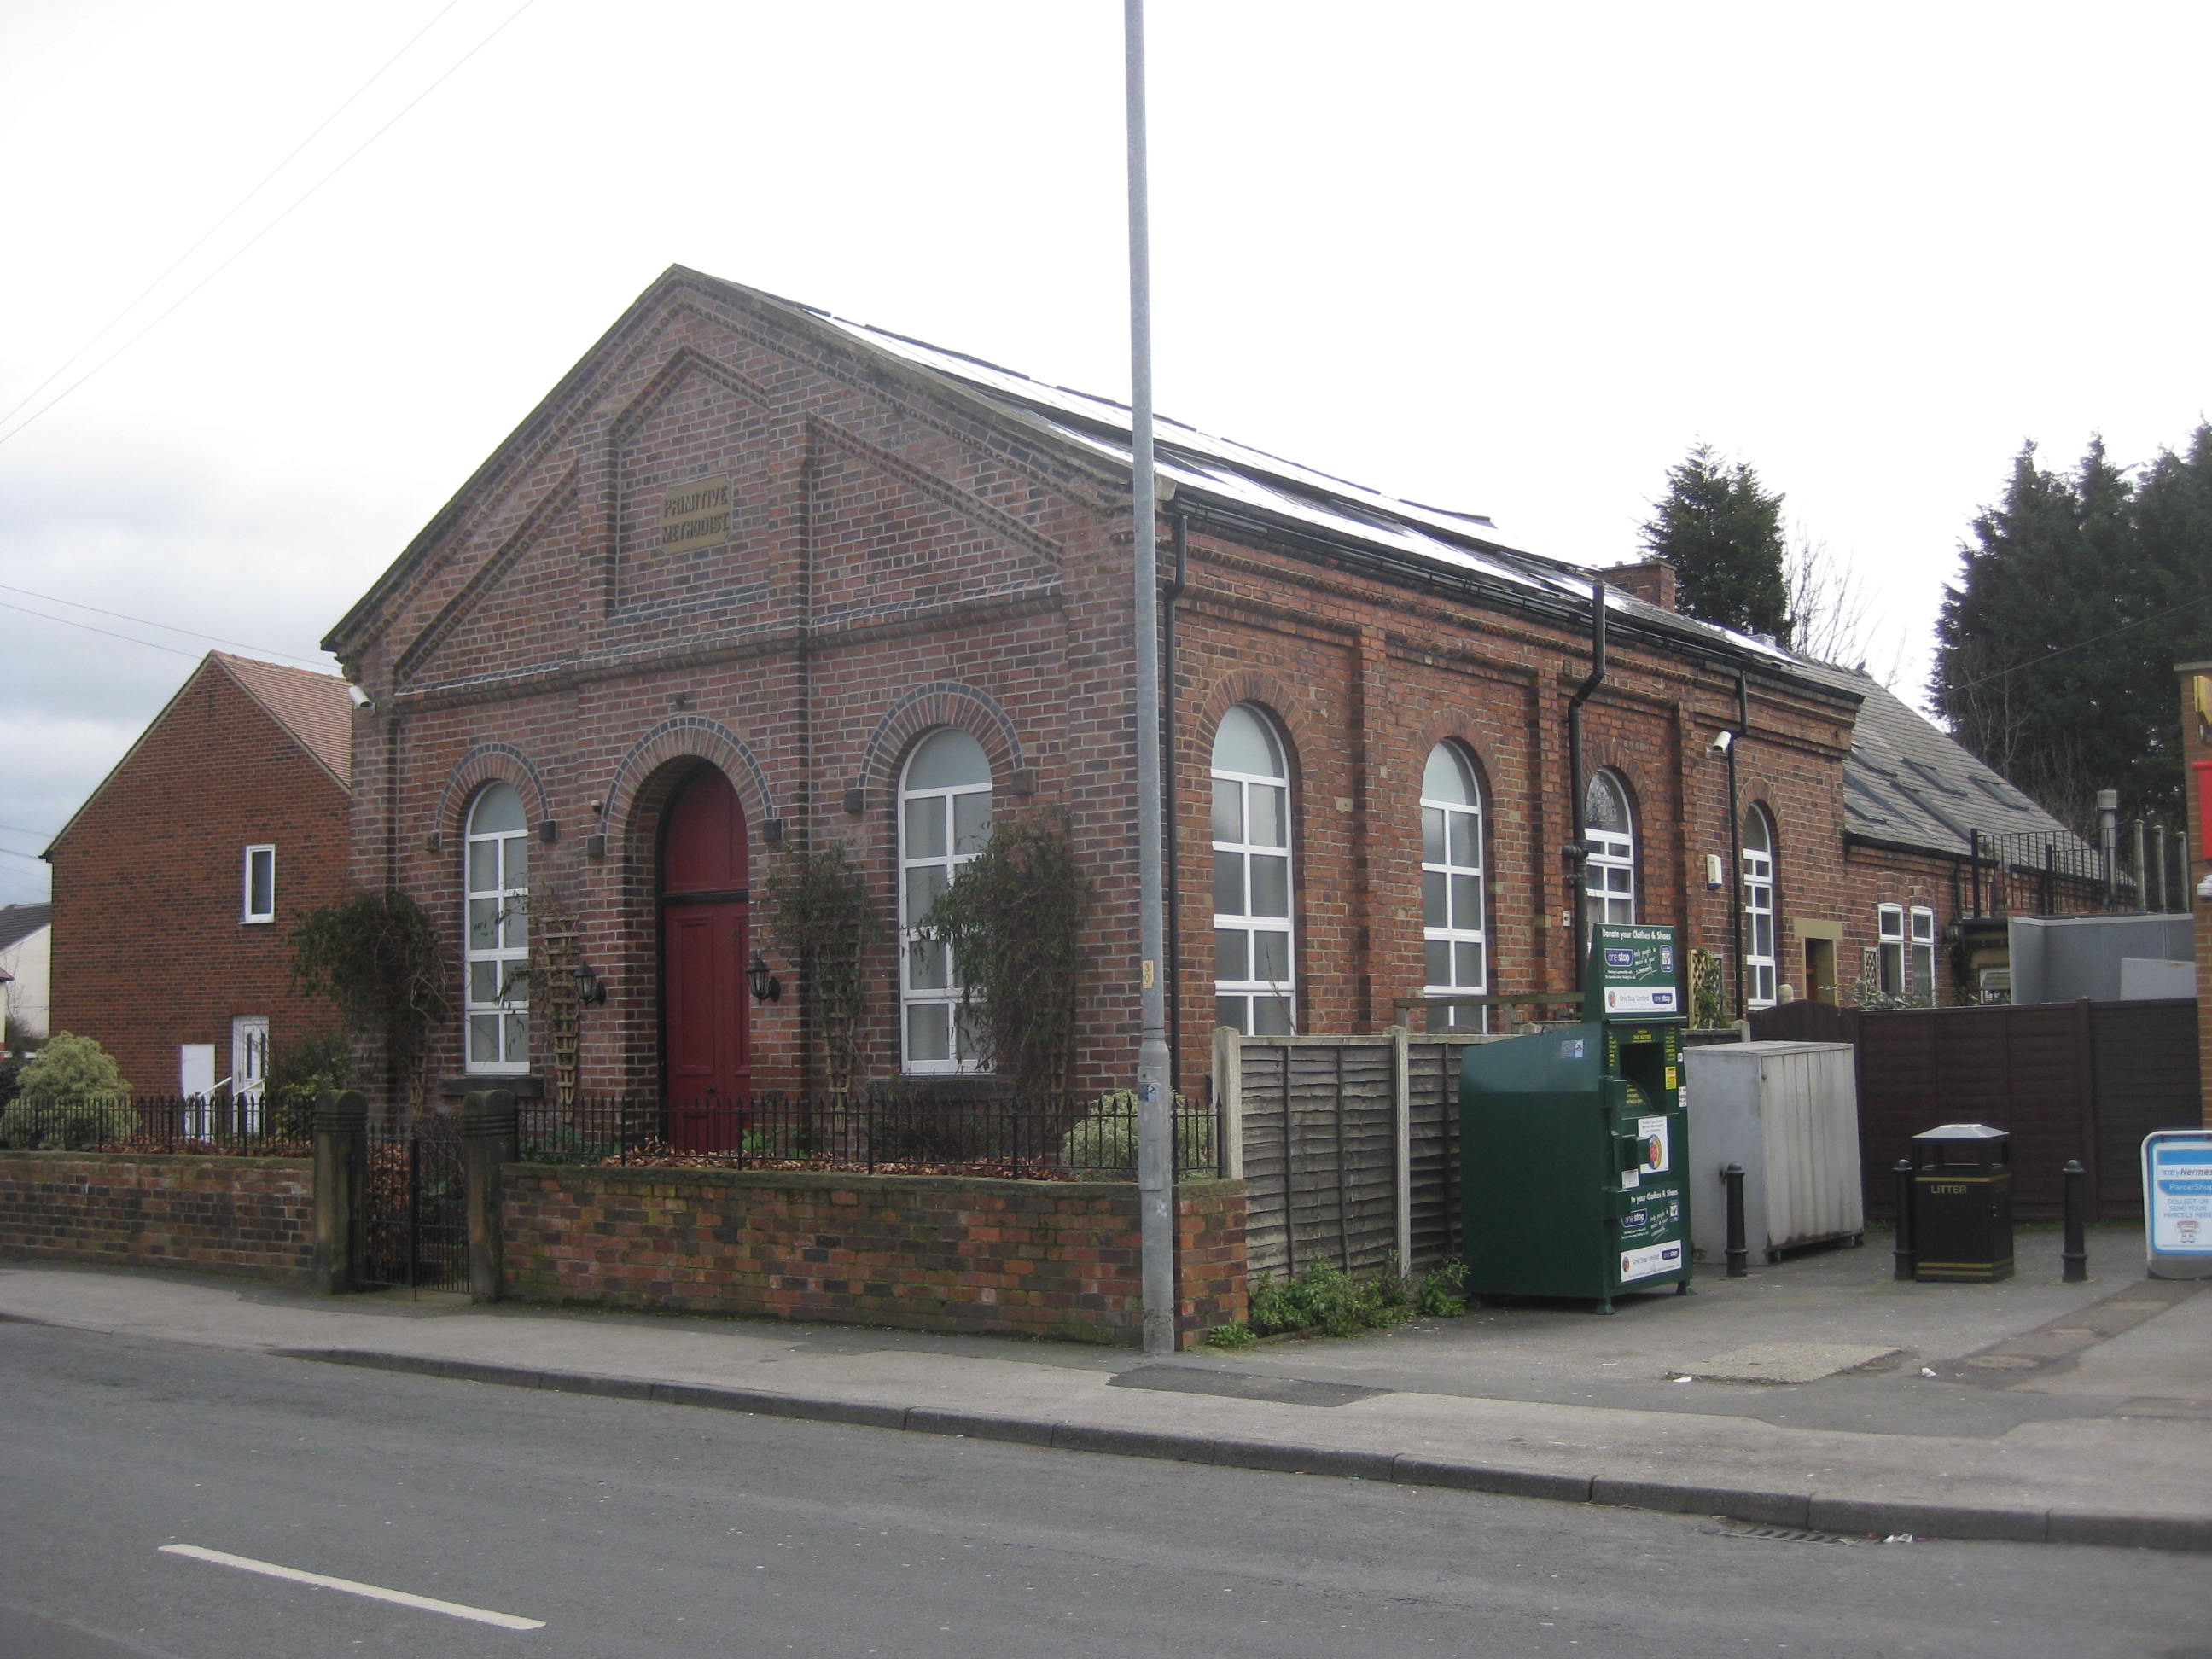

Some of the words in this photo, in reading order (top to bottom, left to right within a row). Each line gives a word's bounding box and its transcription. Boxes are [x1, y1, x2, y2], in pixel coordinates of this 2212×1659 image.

[664, 486, 728, 518] PRIMITIVE
[662, 512, 730, 544] METHODIST
[1602, 928, 1620, 938] Donate
[1620, 931, 1632, 940] your
[1632, 929, 1650, 940] Clothes
[1651, 930, 1656, 940] &
[1656, 930, 1672, 940] Shoes
[1636, 1195, 1646, 1205] your
[1646, 1190, 1662, 1201] Clothes
[1666, 1189, 1679, 1197] Shoes
[1930, 1185, 1967, 1195] LITTER
